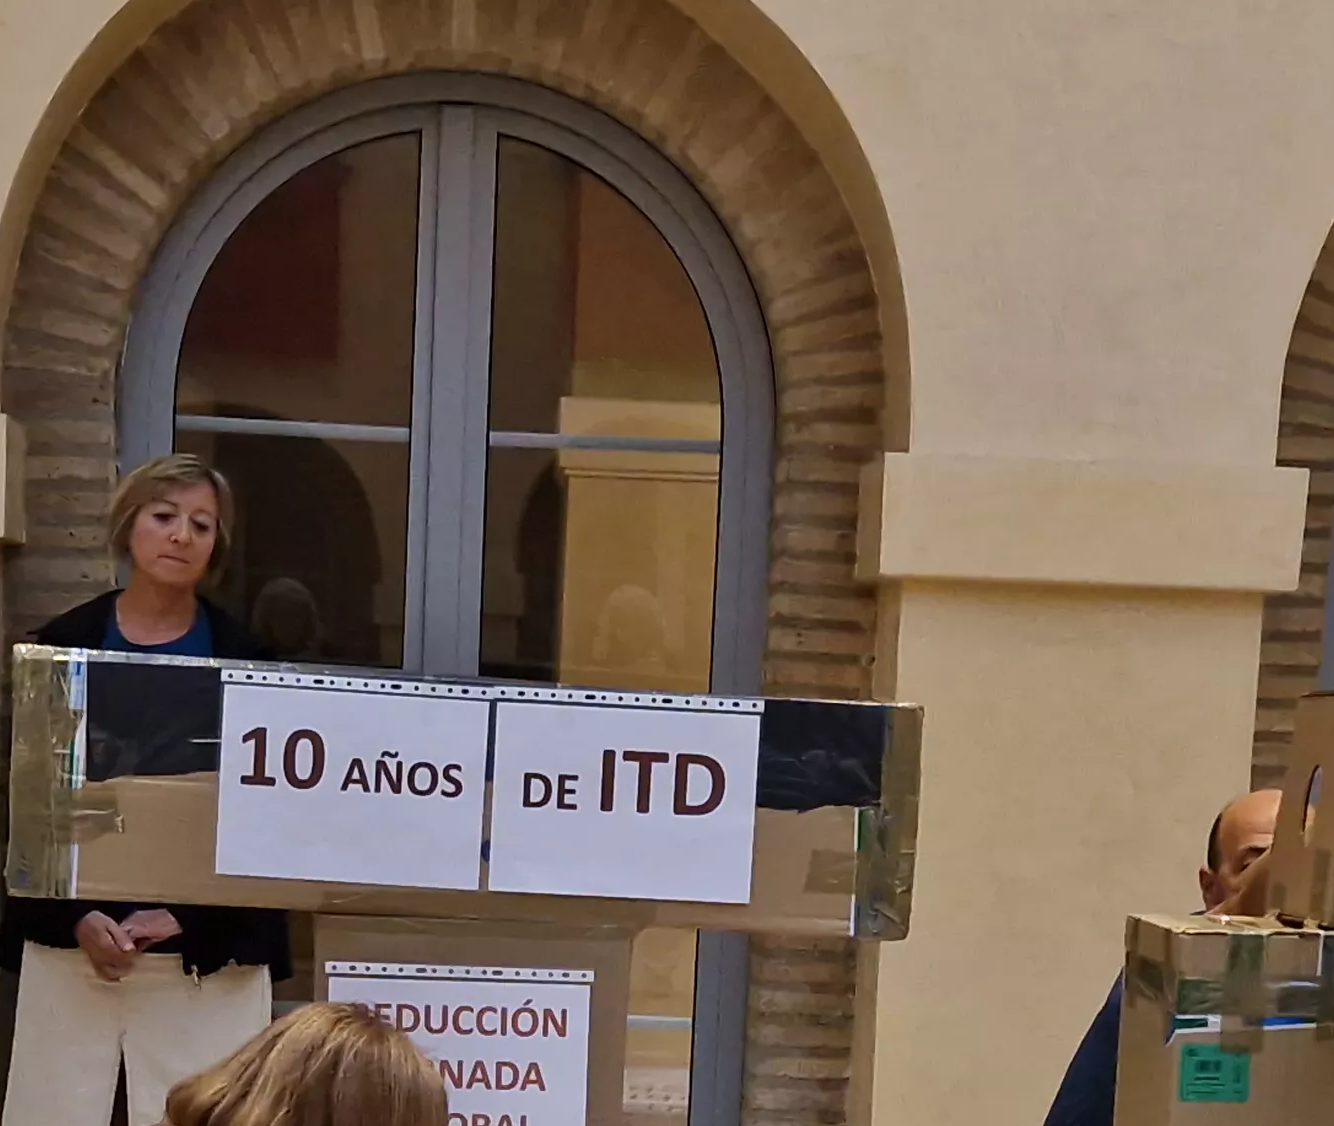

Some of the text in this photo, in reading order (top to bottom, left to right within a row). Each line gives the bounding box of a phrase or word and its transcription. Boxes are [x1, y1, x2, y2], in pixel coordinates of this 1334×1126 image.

[239, 726, 727, 816] 10 AÑOS DE ITD
[373, 998, 567, 1038] EDUCCIÓN
[438, 1059, 547, 1092] NADA
